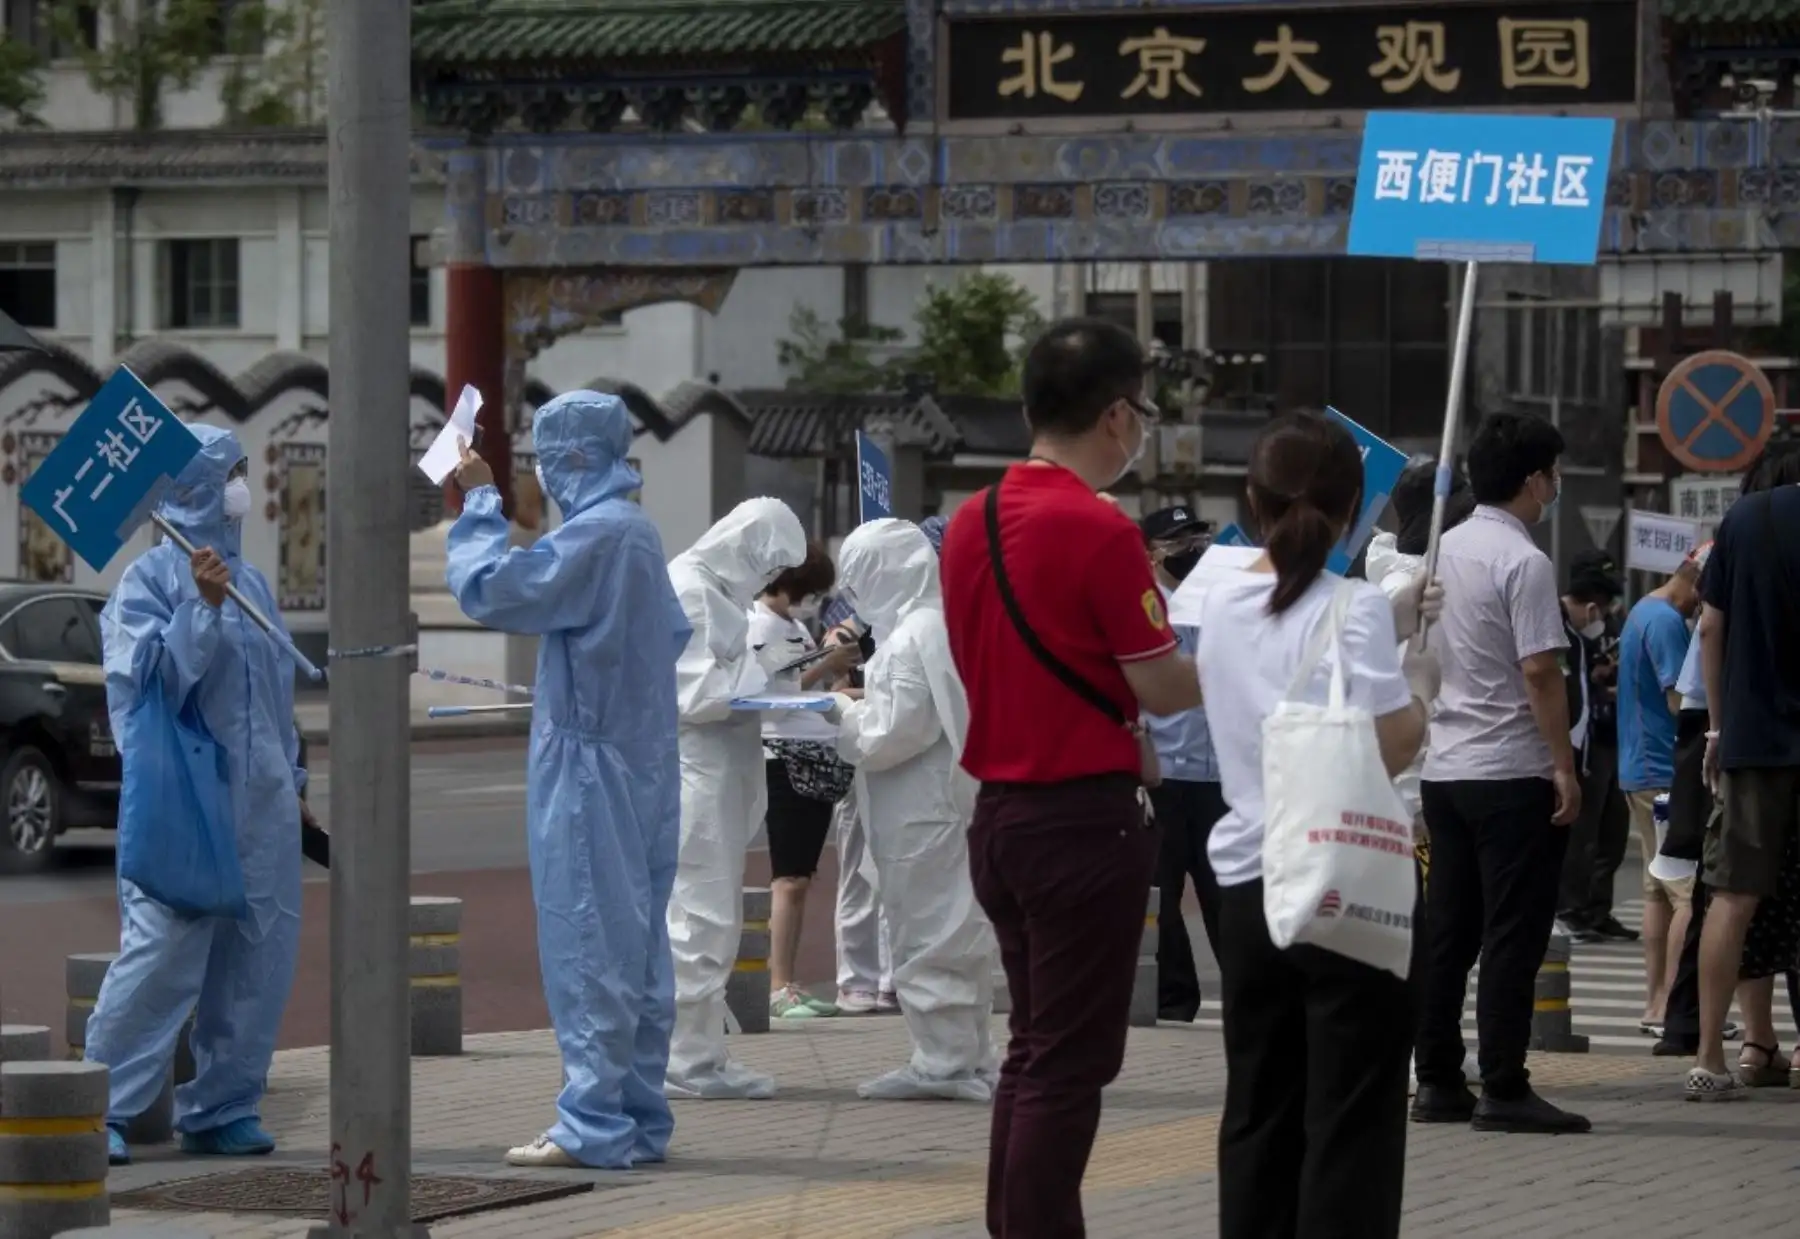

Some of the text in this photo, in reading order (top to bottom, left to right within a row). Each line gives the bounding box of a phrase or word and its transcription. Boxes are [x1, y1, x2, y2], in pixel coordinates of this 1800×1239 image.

[998, 18, 1591, 101] 北京大观园
[1374, 149, 1593, 207] 西便门社区
[52, 396, 164, 533] 广二社区
